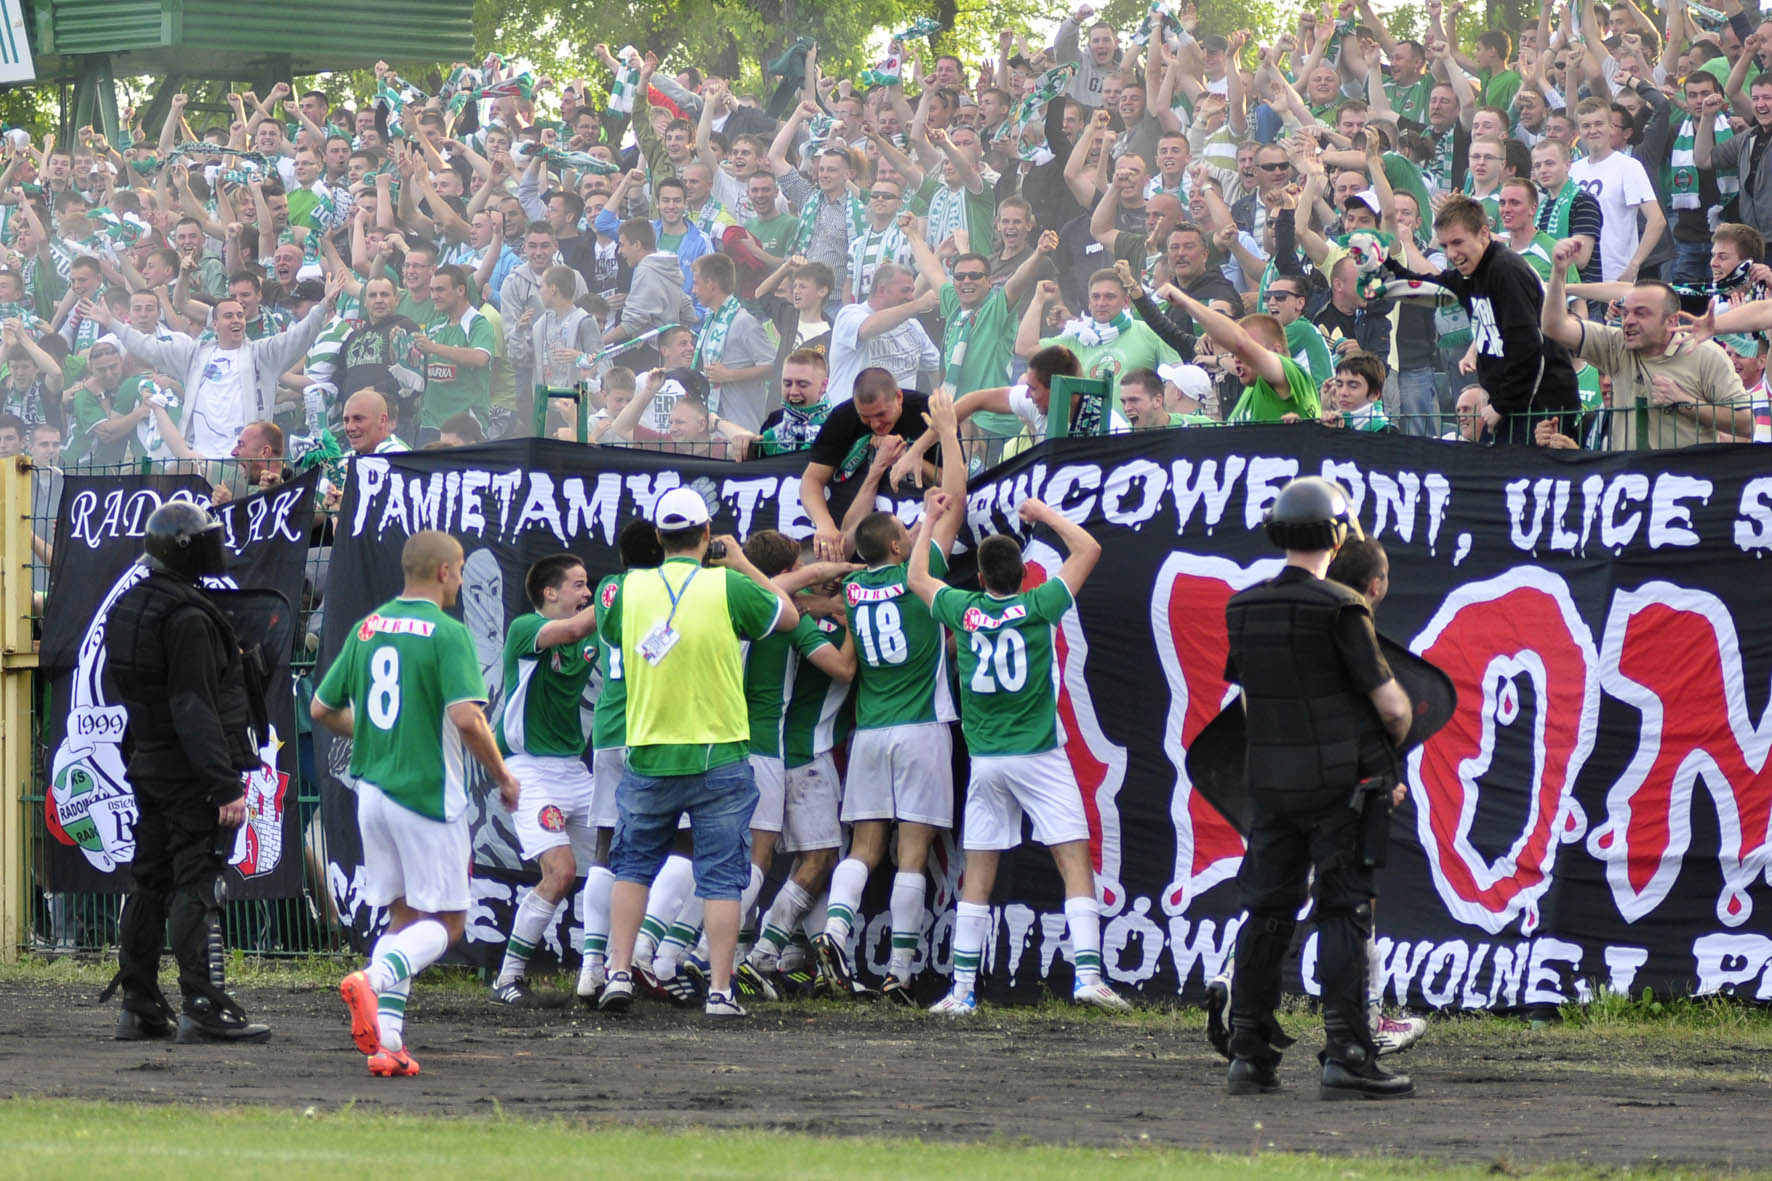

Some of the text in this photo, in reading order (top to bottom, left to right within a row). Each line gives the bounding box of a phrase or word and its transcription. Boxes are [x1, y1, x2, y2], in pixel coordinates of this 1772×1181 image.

[71, 487, 304, 556] RADIAK
[1505, 472, 1713, 559] ULICE
[855, 600, 908, 667] 18
[971, 628, 1028, 693] 20
[368, 646, 400, 730] 8
[76, 713, 124, 735] 1999
[1692, 932, 1772, 1000] P
